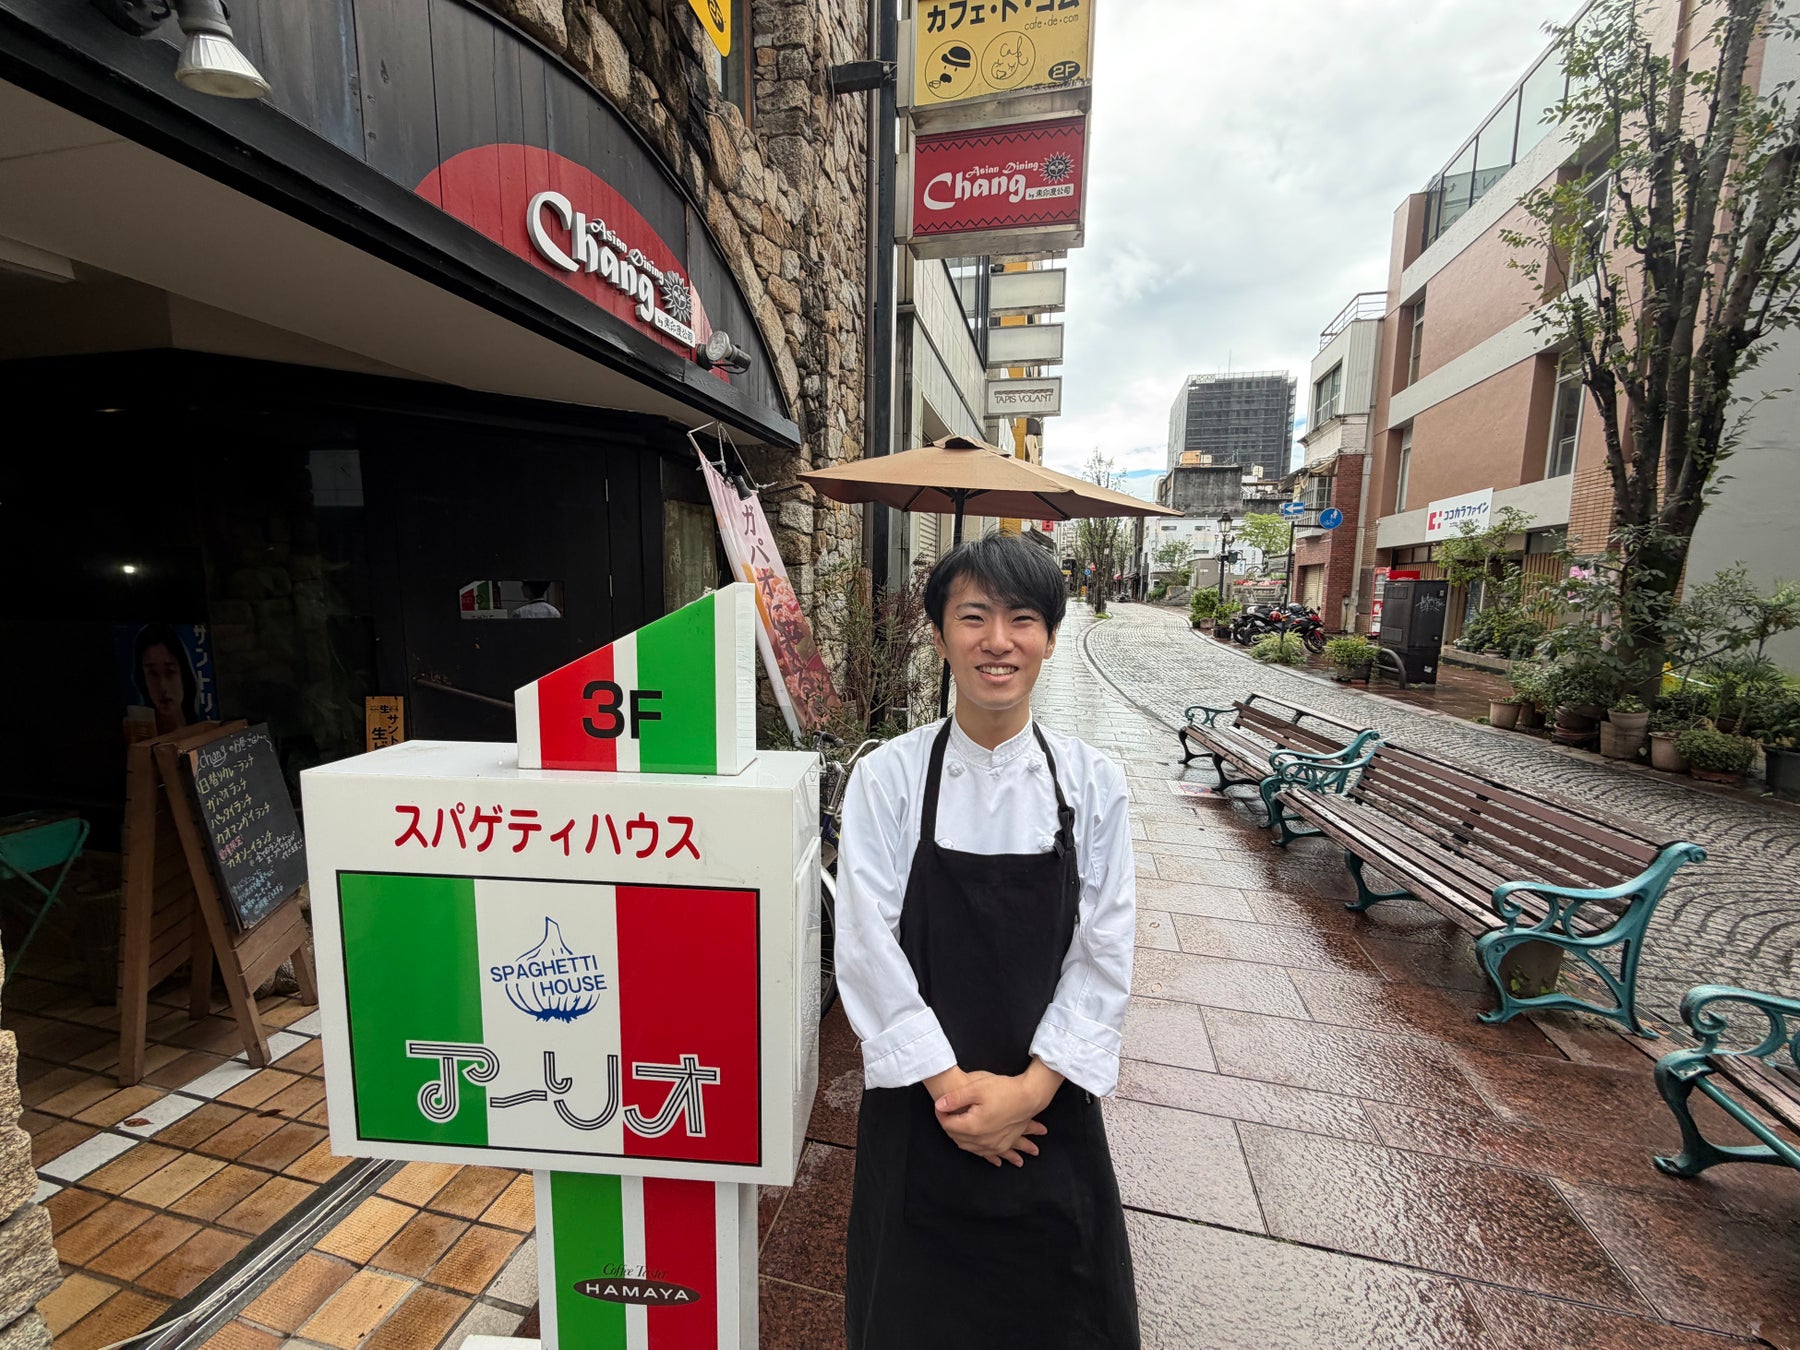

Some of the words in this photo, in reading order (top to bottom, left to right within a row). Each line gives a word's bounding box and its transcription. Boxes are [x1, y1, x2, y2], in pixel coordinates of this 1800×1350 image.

[1052, 62, 1077, 78] 2F
[965, 165, 999, 178] Asian
[1002, 160, 1039, 174] Dining
[923, 171, 1026, 210] Chang
[527, 191, 655, 323] Chang
[589, 218, 628, 253] Asian
[627, 248, 665, 285] Dining
[995, 395, 1017, 404] TAPIS
[1018, 393, 1053, 403] VOLANT
[1443, 502, 1489, 521] ココカラファイン
[582, 680, 663, 739] 3F
[394, 801, 701, 861] スパゲティハウス
[490, 954, 598, 983] SPAGHETTI
[539, 974, 607, 997] HOUSE
[406, 1039, 721, 1139] アーリオ
[602, 1262, 634, 1276] Coffee
[635, 1264, 668, 1279] Taster
[585, 1283, 690, 1300] HAMAYA
